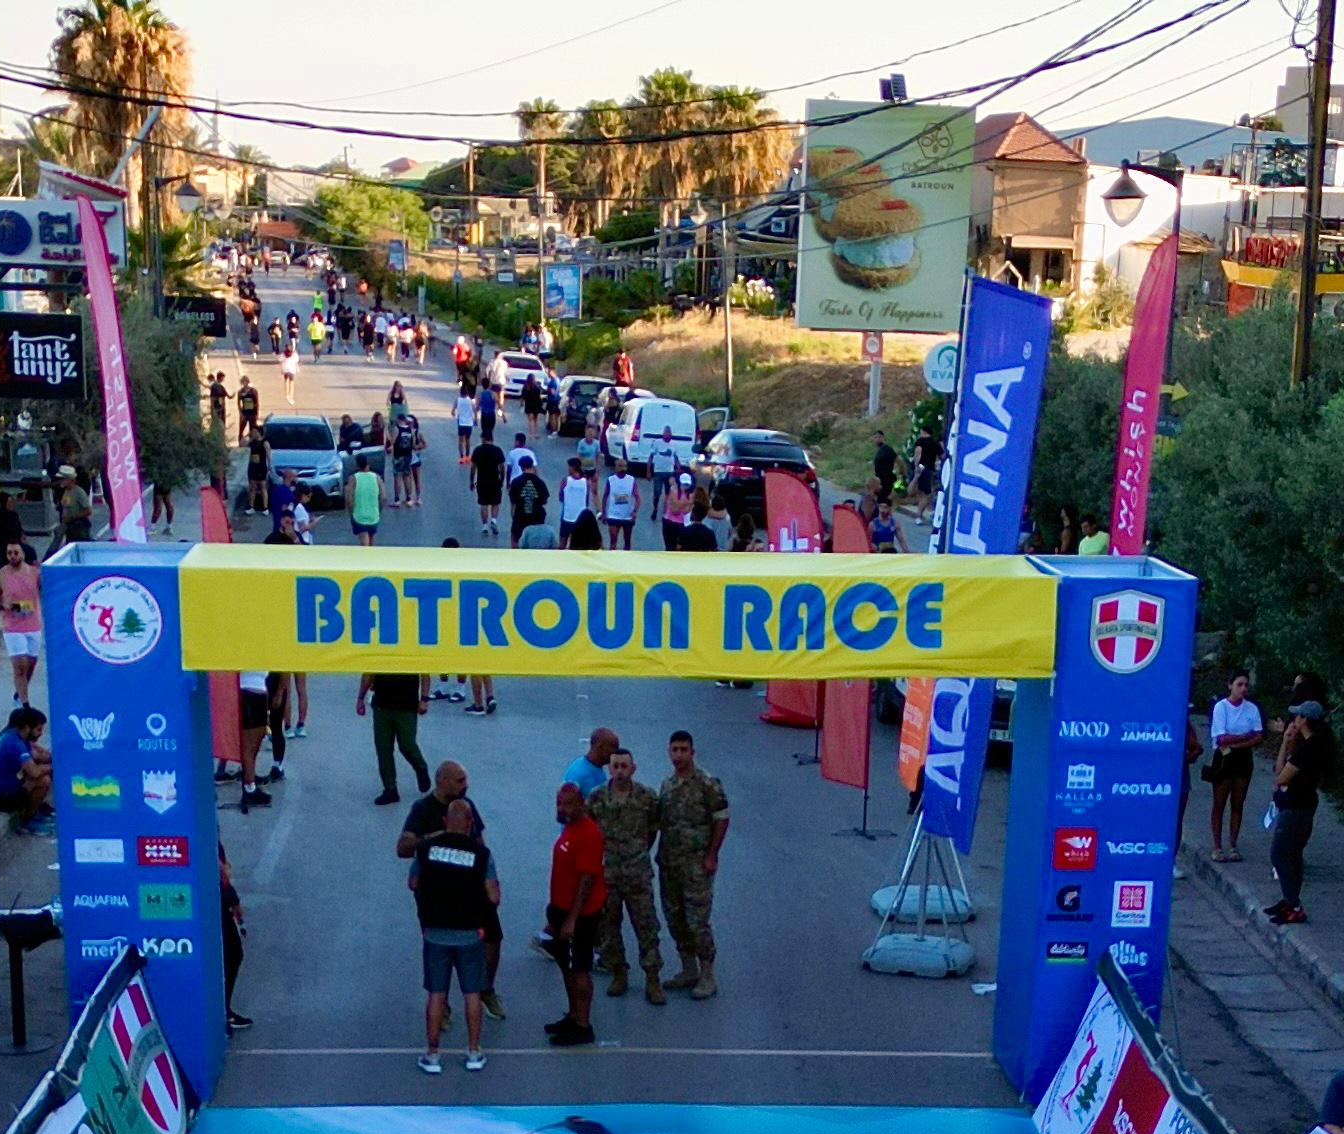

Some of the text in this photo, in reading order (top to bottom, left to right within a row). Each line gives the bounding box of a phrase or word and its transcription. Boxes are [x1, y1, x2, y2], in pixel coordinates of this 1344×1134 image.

[911, 181, 954, 190] BATROUN
[1117, 389, 1147, 530] whish
[295, 575, 944, 651] BATROUN RACE
[1059, 720, 1110, 737] MOOD
[1121, 731, 1172, 742] JAMMAL
[138, 738, 177, 751] ROUTES
[1111, 782, 1172, 795] FOOTLAB
[73, 893, 129, 909] AQUAFINA
